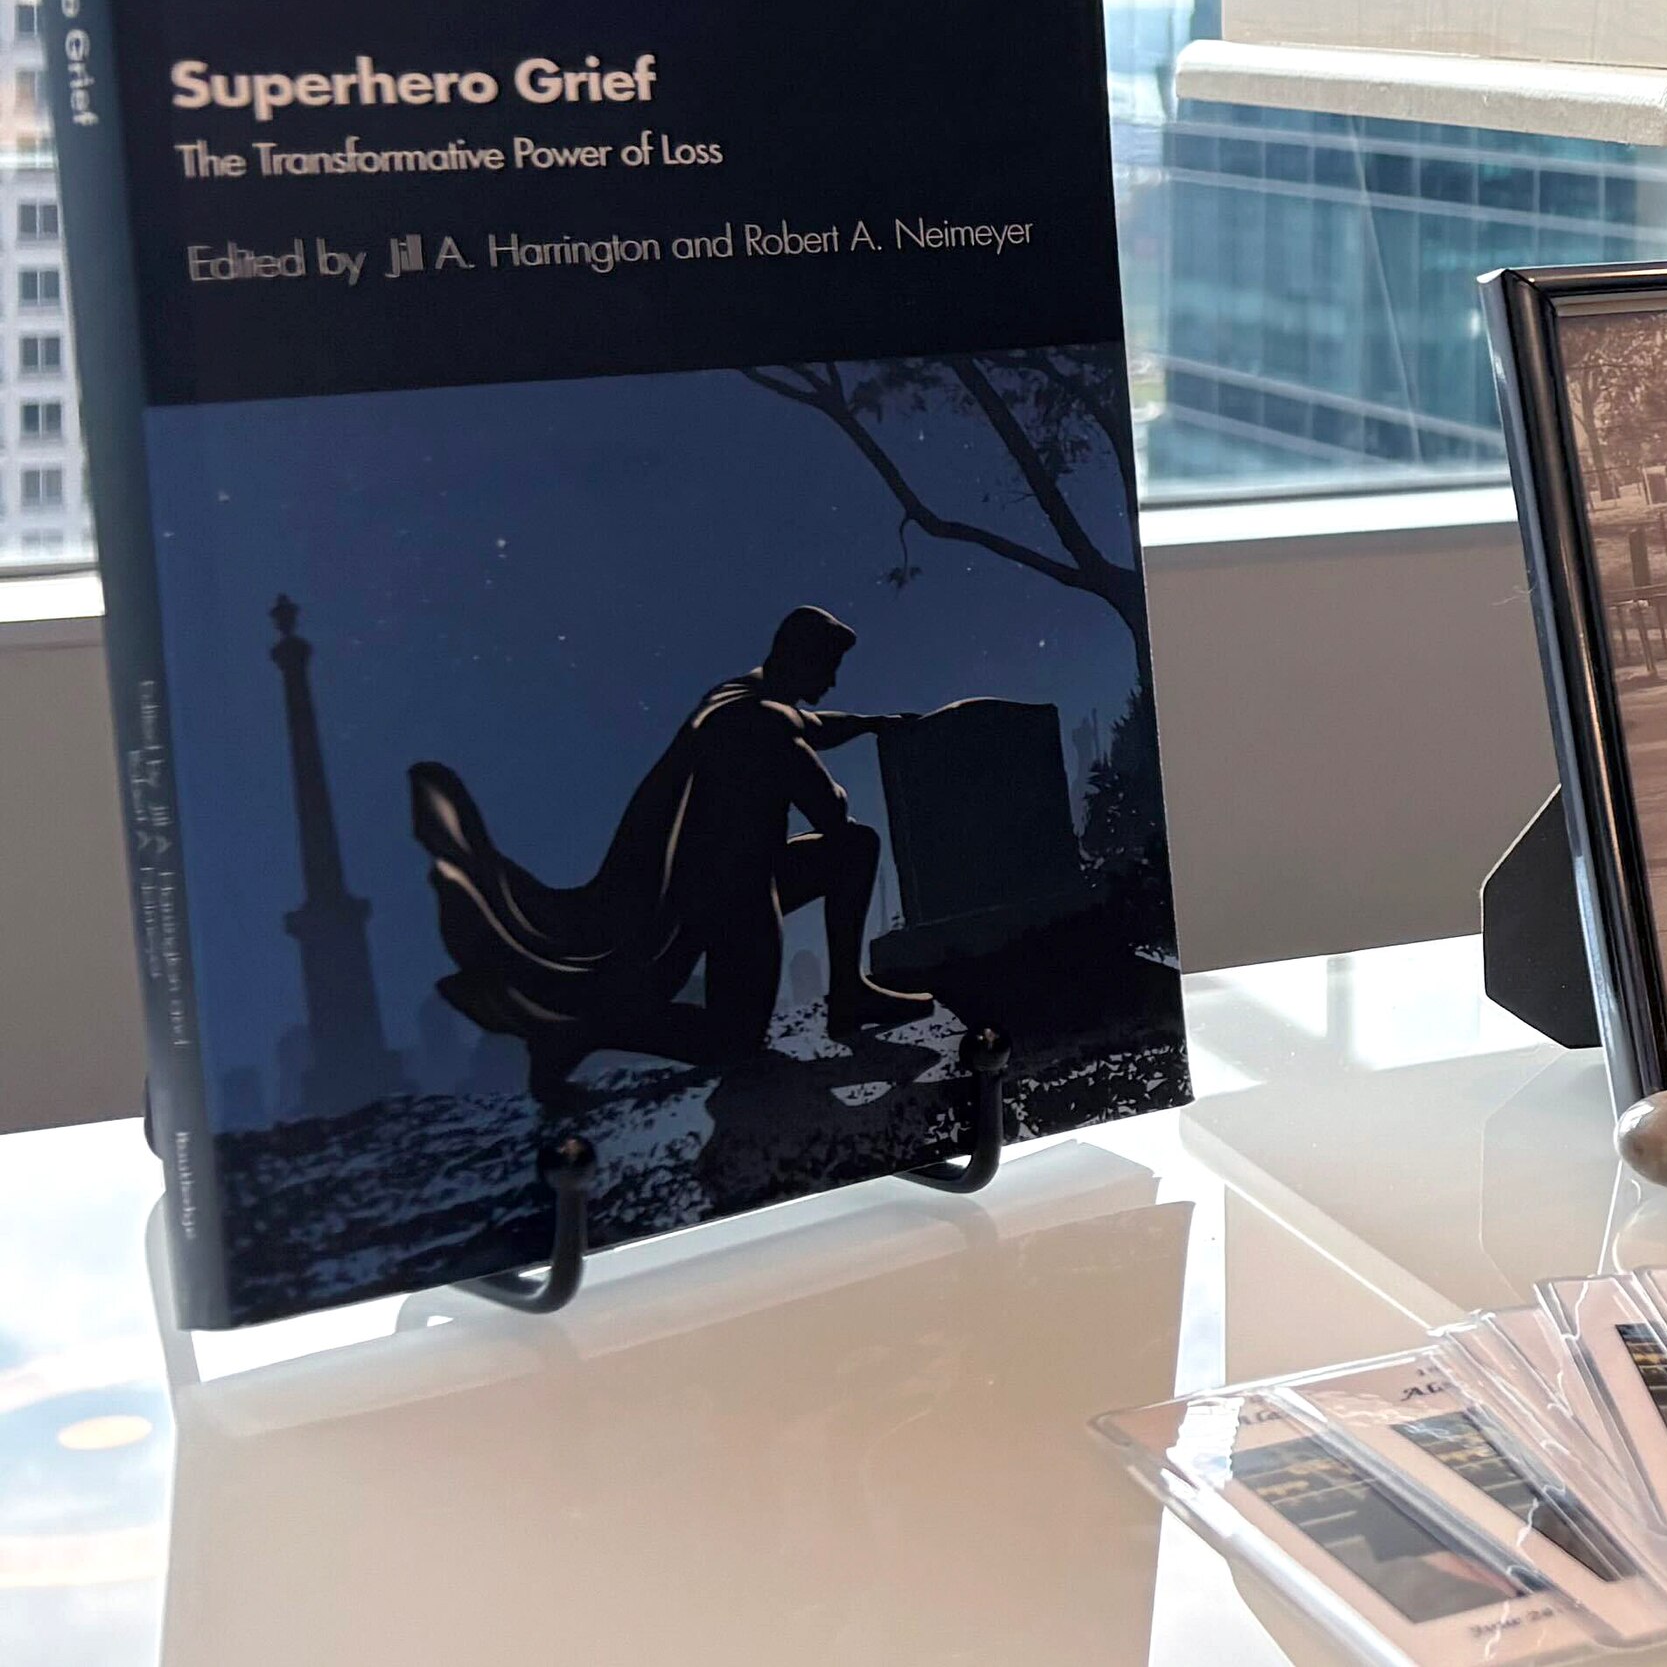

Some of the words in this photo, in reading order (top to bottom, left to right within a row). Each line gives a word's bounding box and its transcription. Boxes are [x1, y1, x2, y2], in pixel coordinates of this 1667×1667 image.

[66, 29, 99, 126] Grief
[171, 55, 499, 122] Superhero
[514, 54, 657, 103] Grief
[174, 140, 247, 177] The
[252, 135, 506, 177] Transformative
[513, 136, 613, 170] Power
[620, 130, 654, 167] of
[660, 133, 724, 166] Loss
[187, 237, 306, 282] Edited
[315, 237, 367, 285] by
[385, 233, 425, 278] Jill
[434, 236, 476, 270] A.
[488, 233, 661, 274] Harrington
[671, 222, 734, 259] and
[744, 219, 839, 256] Robert
[850, 220, 883, 252] A.
[895, 217, 1034, 255] Neimeyer
